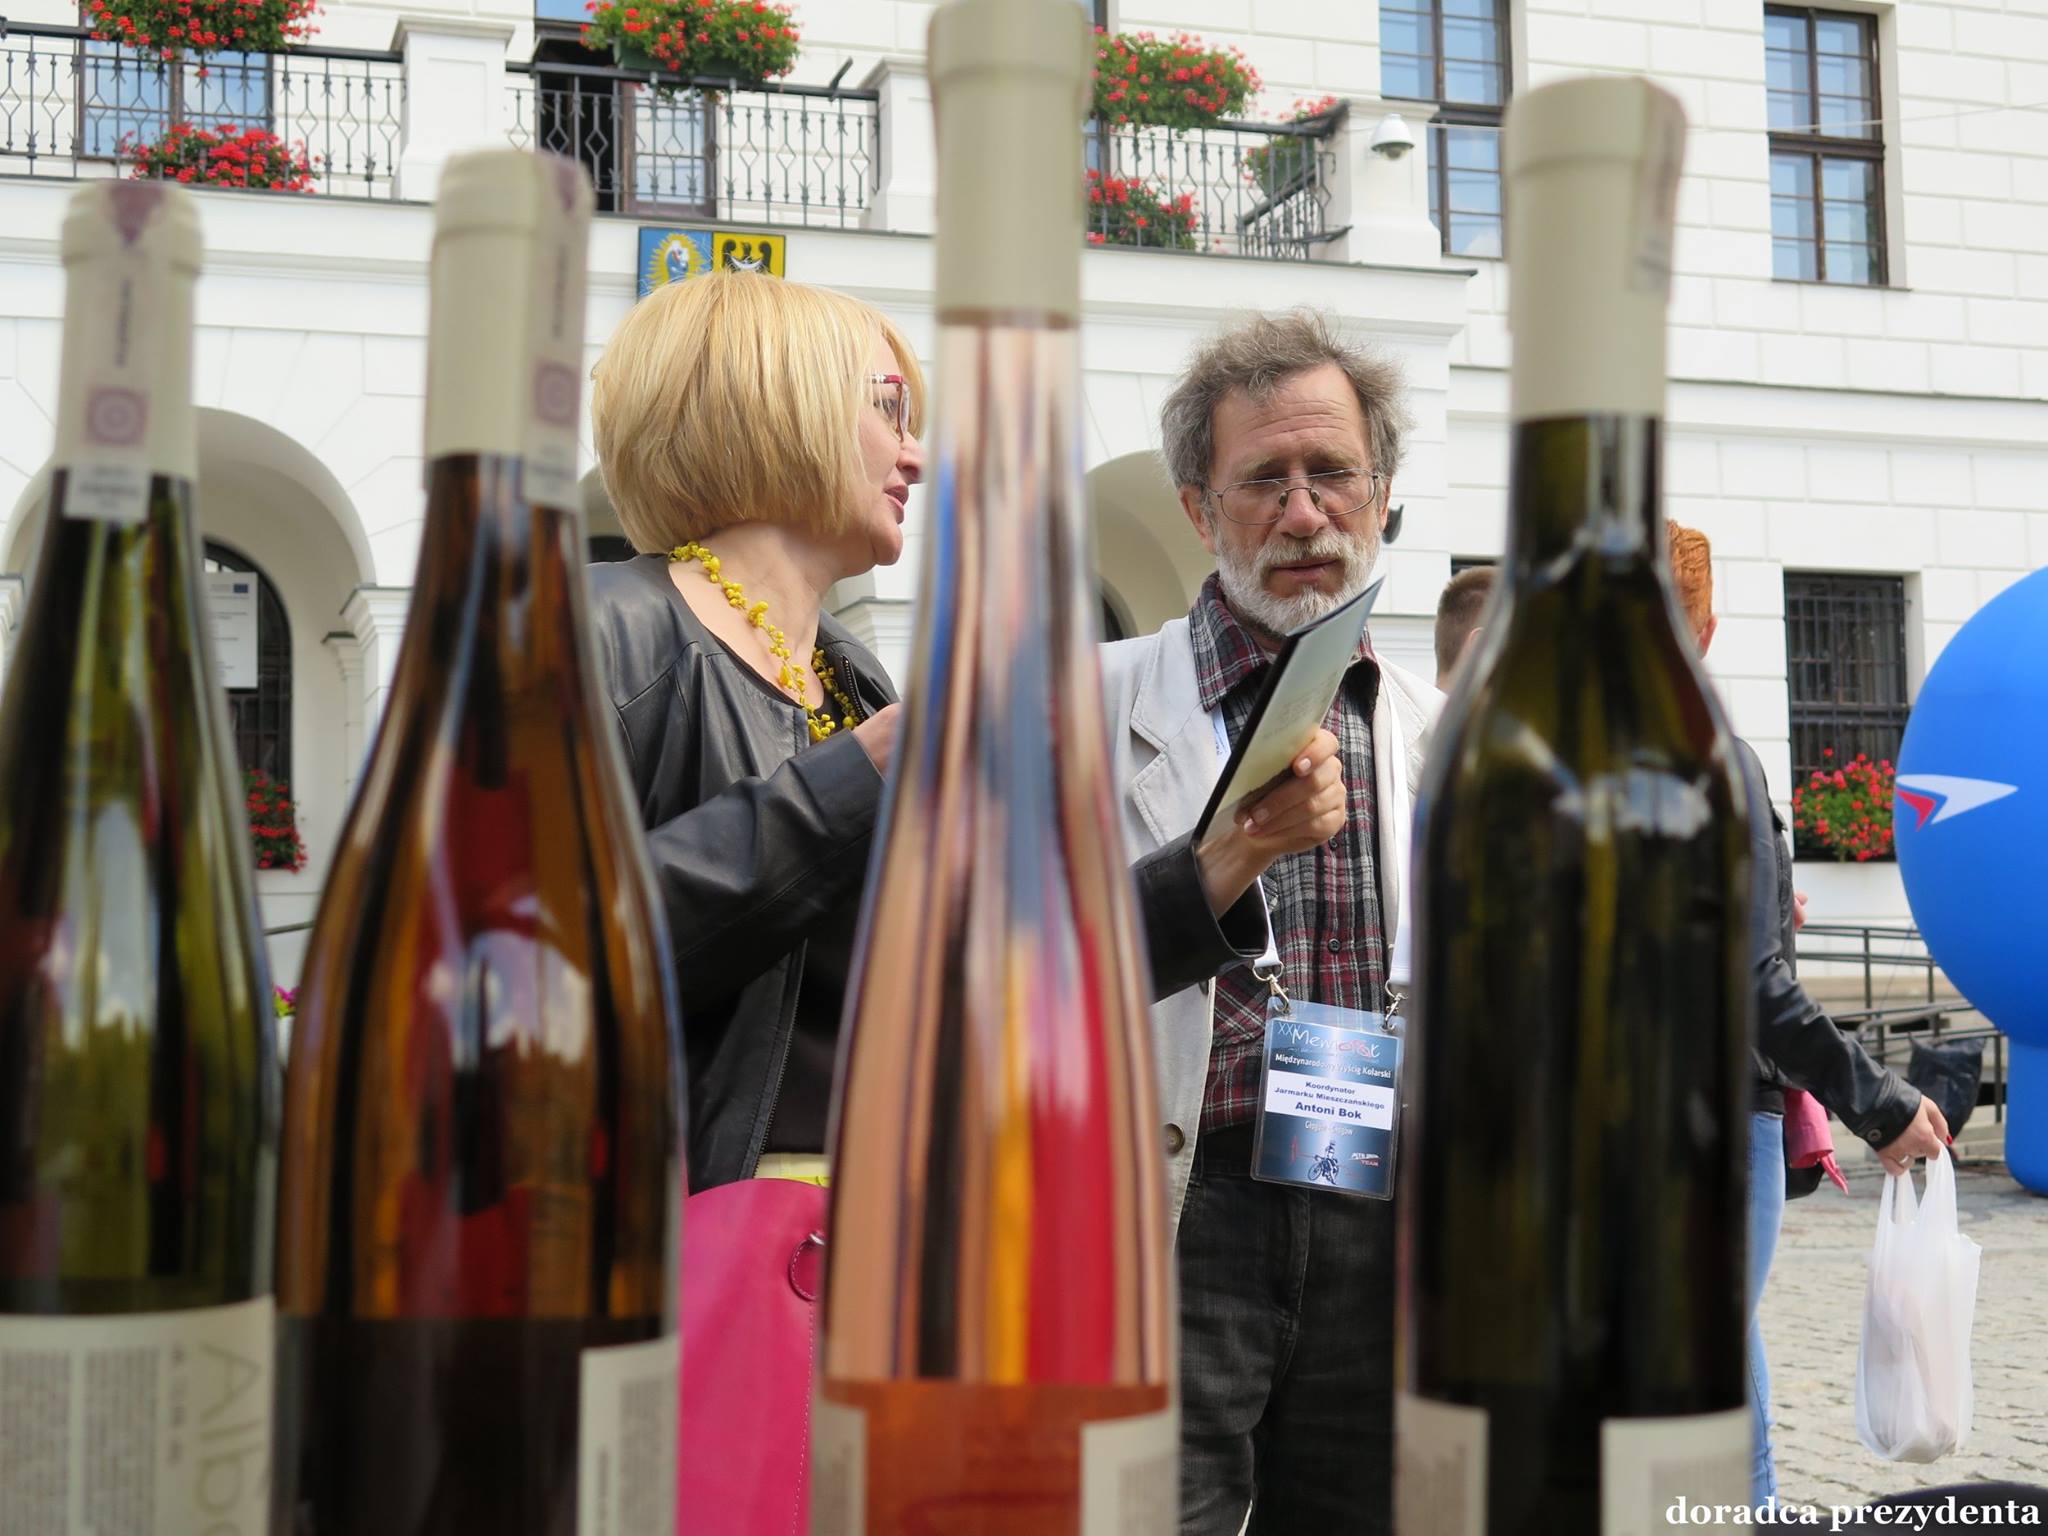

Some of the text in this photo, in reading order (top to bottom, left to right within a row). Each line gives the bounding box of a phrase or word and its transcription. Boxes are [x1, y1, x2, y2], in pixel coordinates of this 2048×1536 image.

[1362, 1066, 1391, 1079] Kolarski
[1274, 1087, 1314, 1099] Jarmarku
[1305, 1081, 1356, 1095] Koordynator
[1295, 1101, 1362, 1120] Antoni Bok
